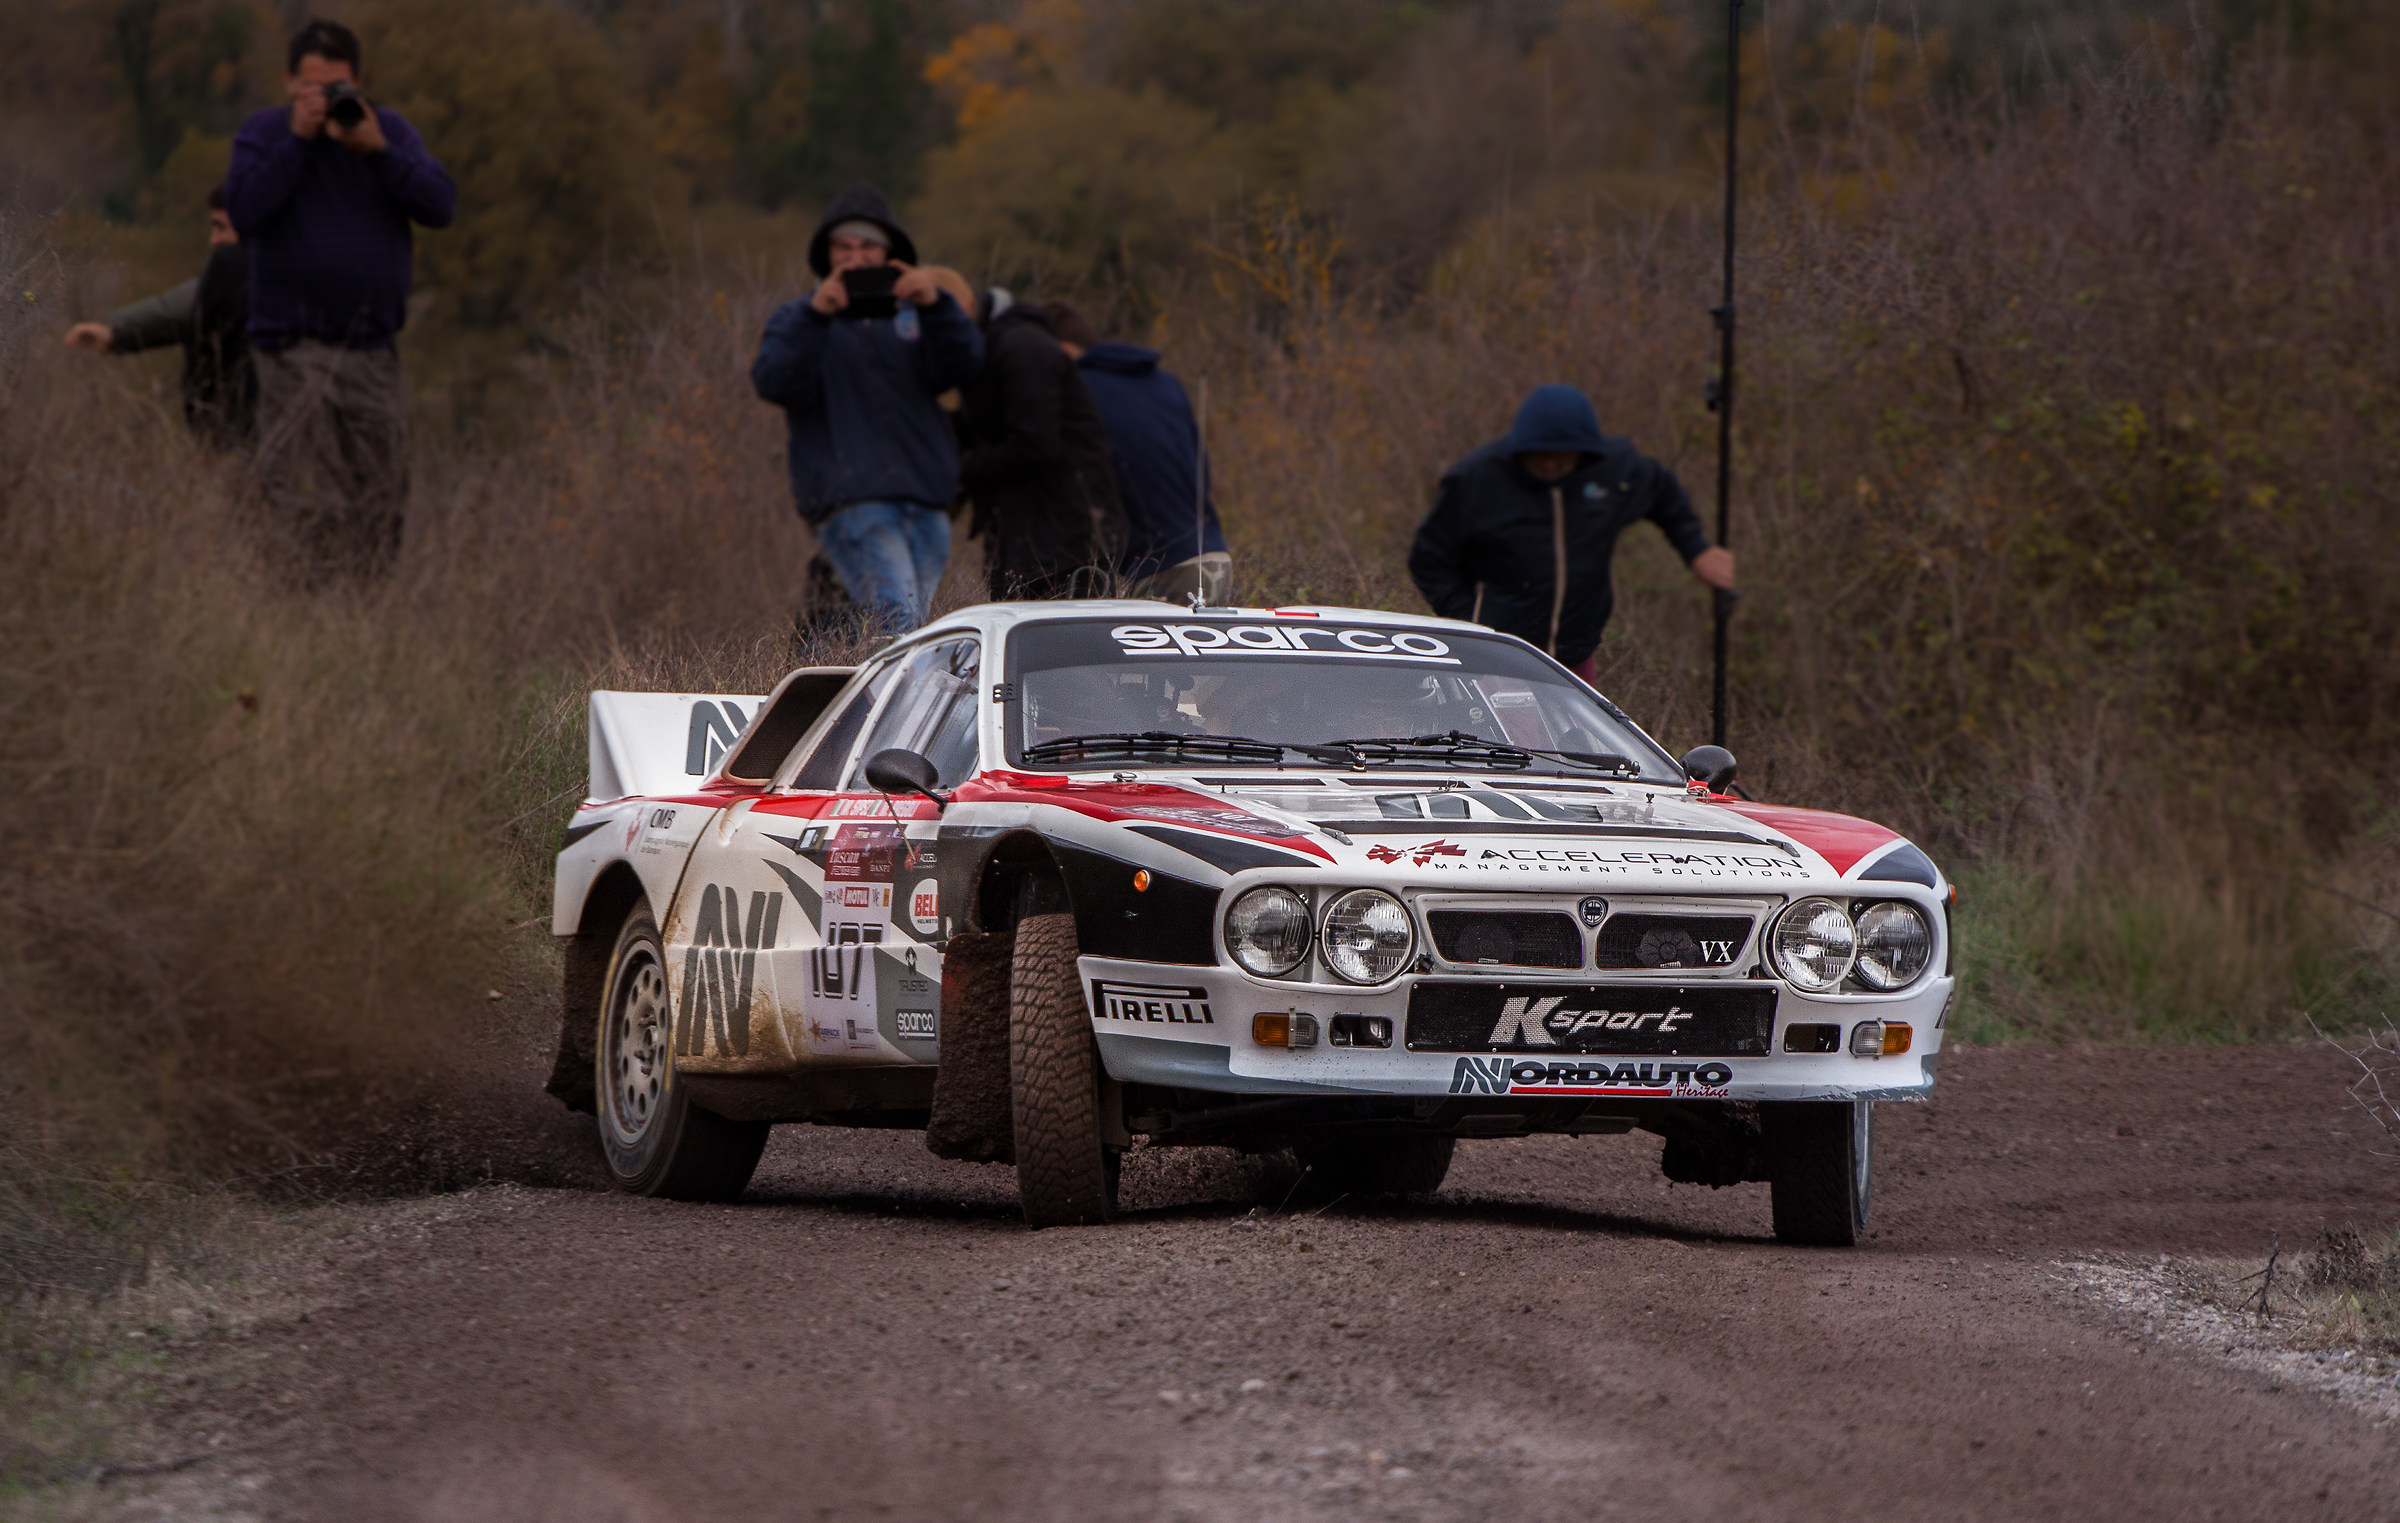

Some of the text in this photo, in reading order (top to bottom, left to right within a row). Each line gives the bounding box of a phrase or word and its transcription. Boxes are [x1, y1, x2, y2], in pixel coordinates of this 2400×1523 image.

[1111, 624, 1450, 657] sparco
[1435, 863, 1811, 878] MANAGEMENT SOLUTIONS
[1480, 850, 1803, 869] ACCELERATION
[846, 890, 868, 905] MOTUL
[1700, 941, 1734, 963] VX
[1091, 979, 1214, 1024] PIRELLI
[897, 1012, 935, 1039] sparco
[1449, 1056, 1733, 1094] NORDAUTO
[1675, 1083, 1730, 1098] Heritage
